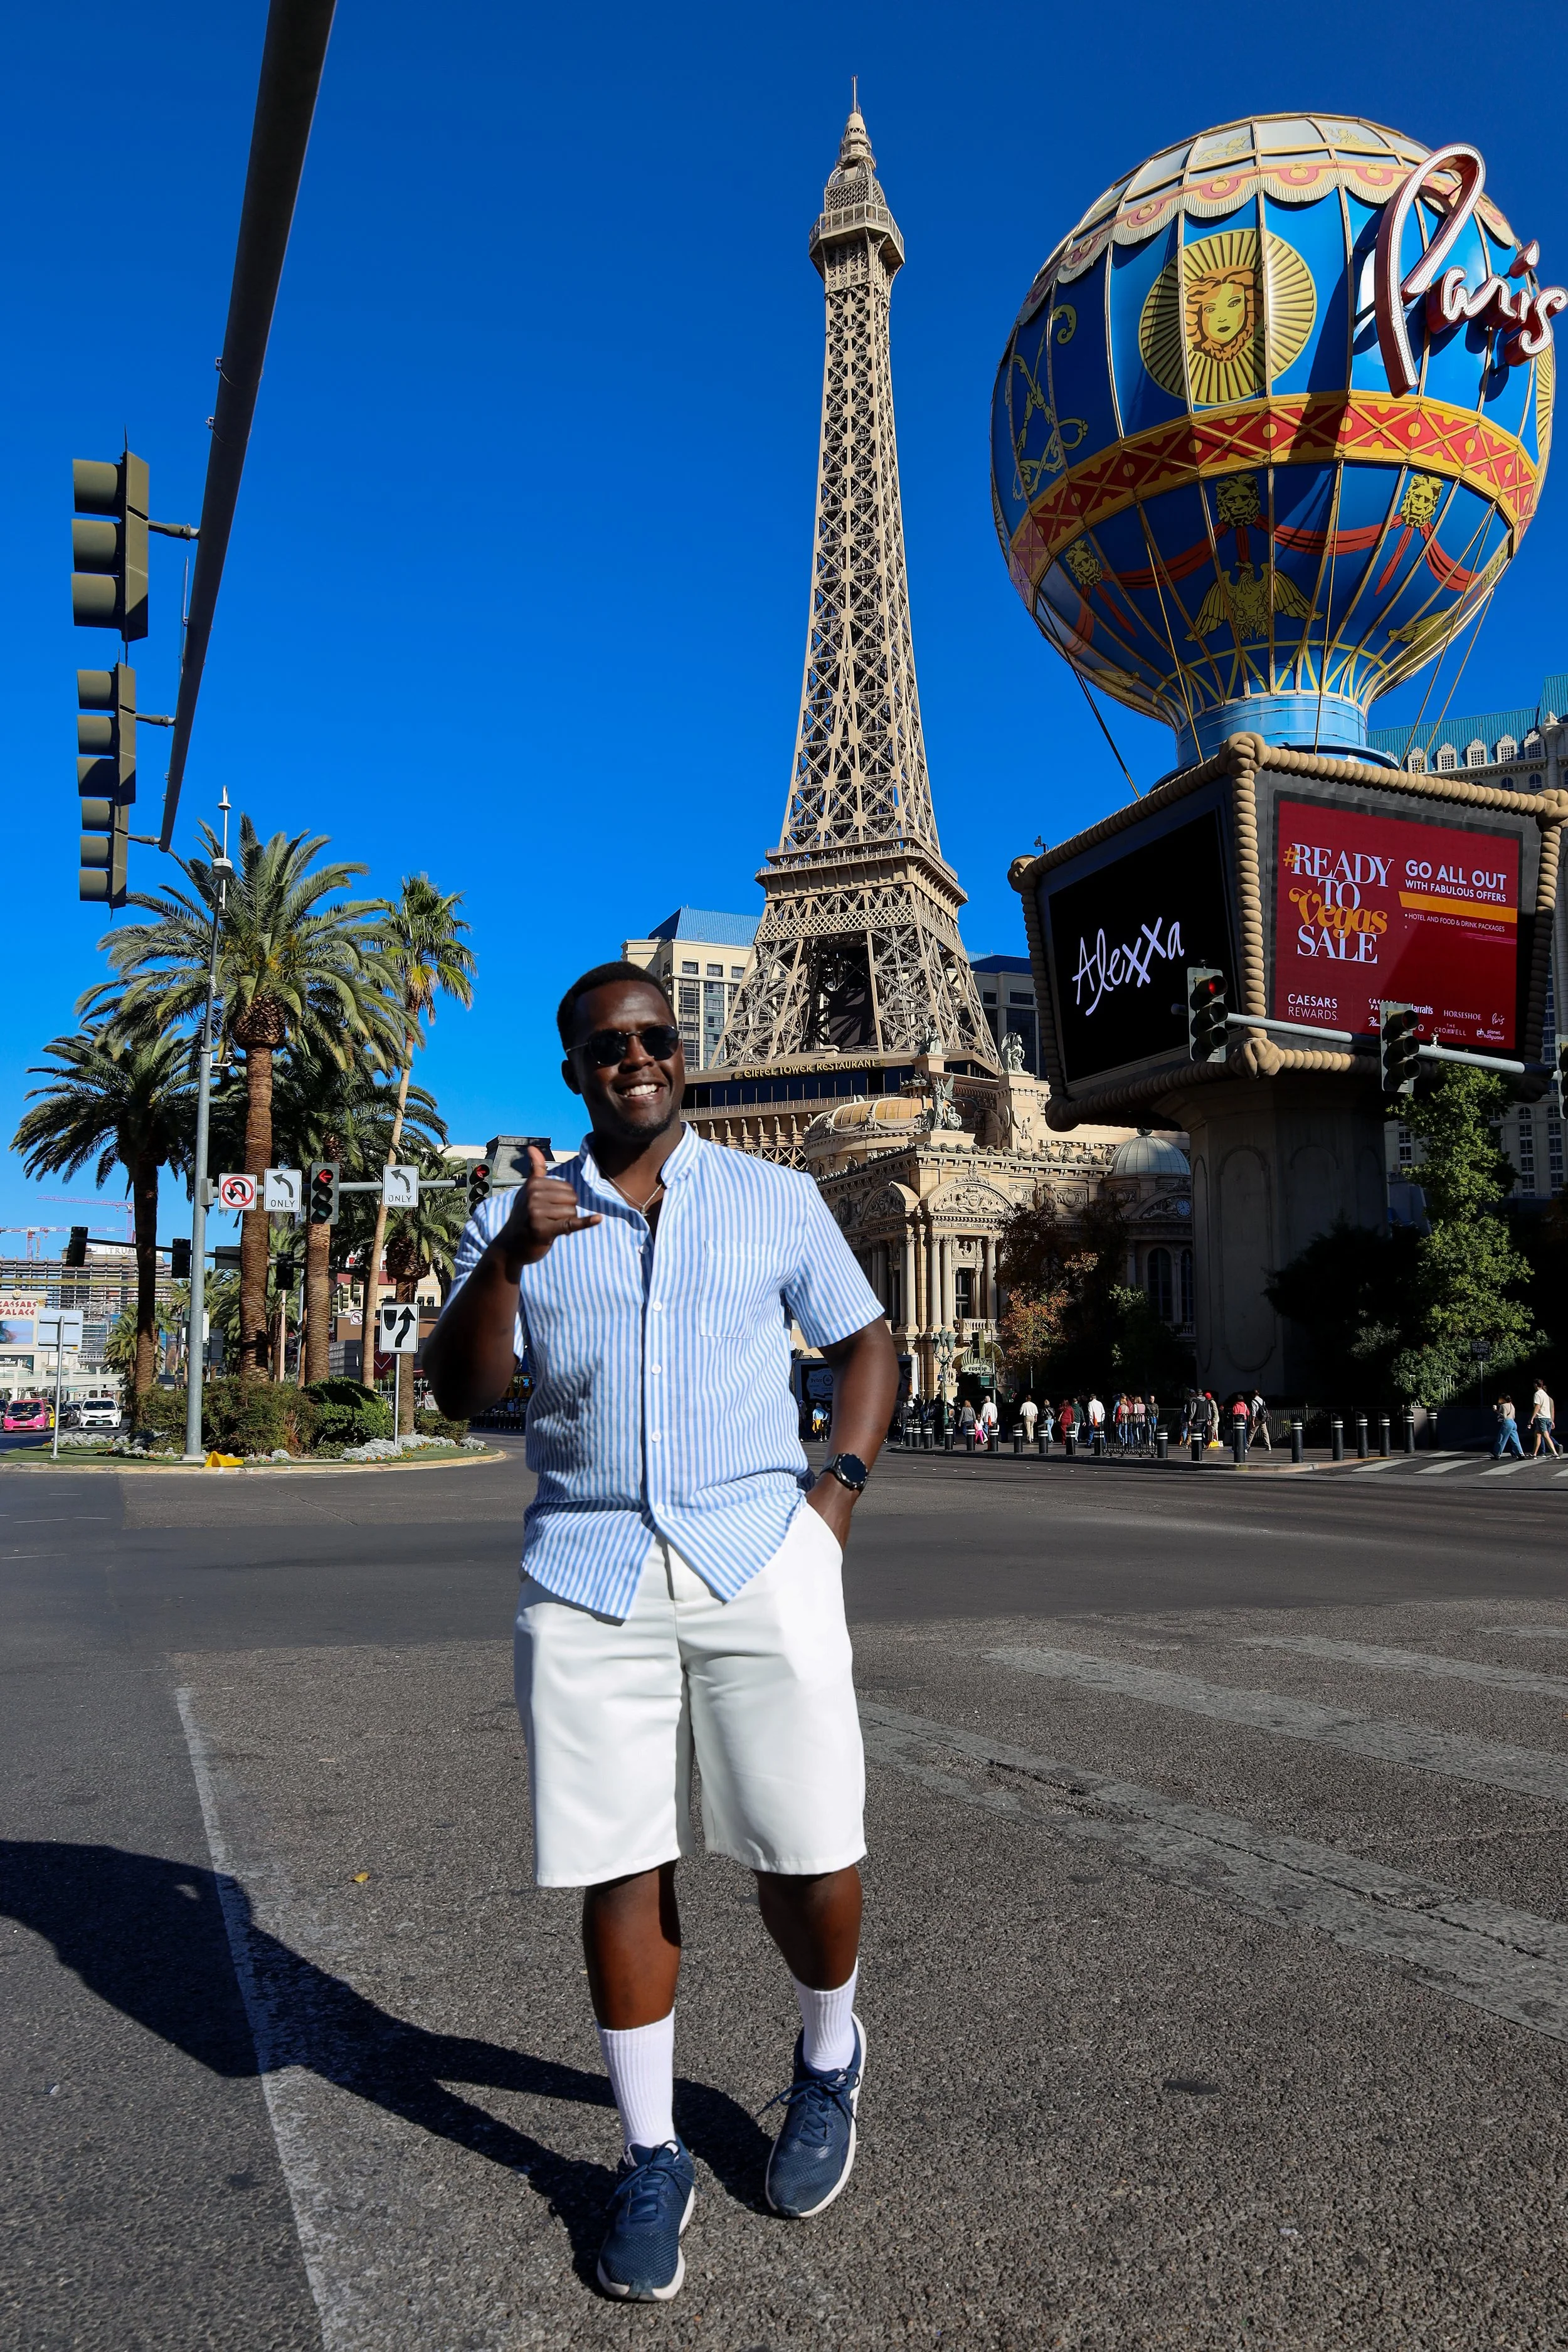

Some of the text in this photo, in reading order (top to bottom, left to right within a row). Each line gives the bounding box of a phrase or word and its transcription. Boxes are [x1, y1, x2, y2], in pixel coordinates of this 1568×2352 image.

[1377, 142, 1568, 398] Paris
[1283, 842, 1395, 887] #READY
[1405, 859, 1507, 890] GO ALL OUT
[1318, 877, 1361, 912] TO
[1405, 879, 1506, 903] WITH FABULOUS OFFERS
[1288, 887, 1388, 939] Vegas
[1408, 913, 1426, 921] HOTEL
[1478, 923, 1505, 932] PACKAGES
[1297, 924, 1377, 963] SALE
[1288, 993, 1338, 1009] CAESARS
[1288, 1006, 1337, 1020] REWARDS
[1443, 1010, 1482, 1020] HORSESHOE
[1491, 1012, 1505, 1025] Paris
[1434, 1027, 1466, 1036] CROMWELL
[744, 1058, 877, 1078] EIFFEL TOWER RESTAURANT
[270, 1199, 295, 1207] ONLY
[388, 1195, 412, 1203] ONLY
